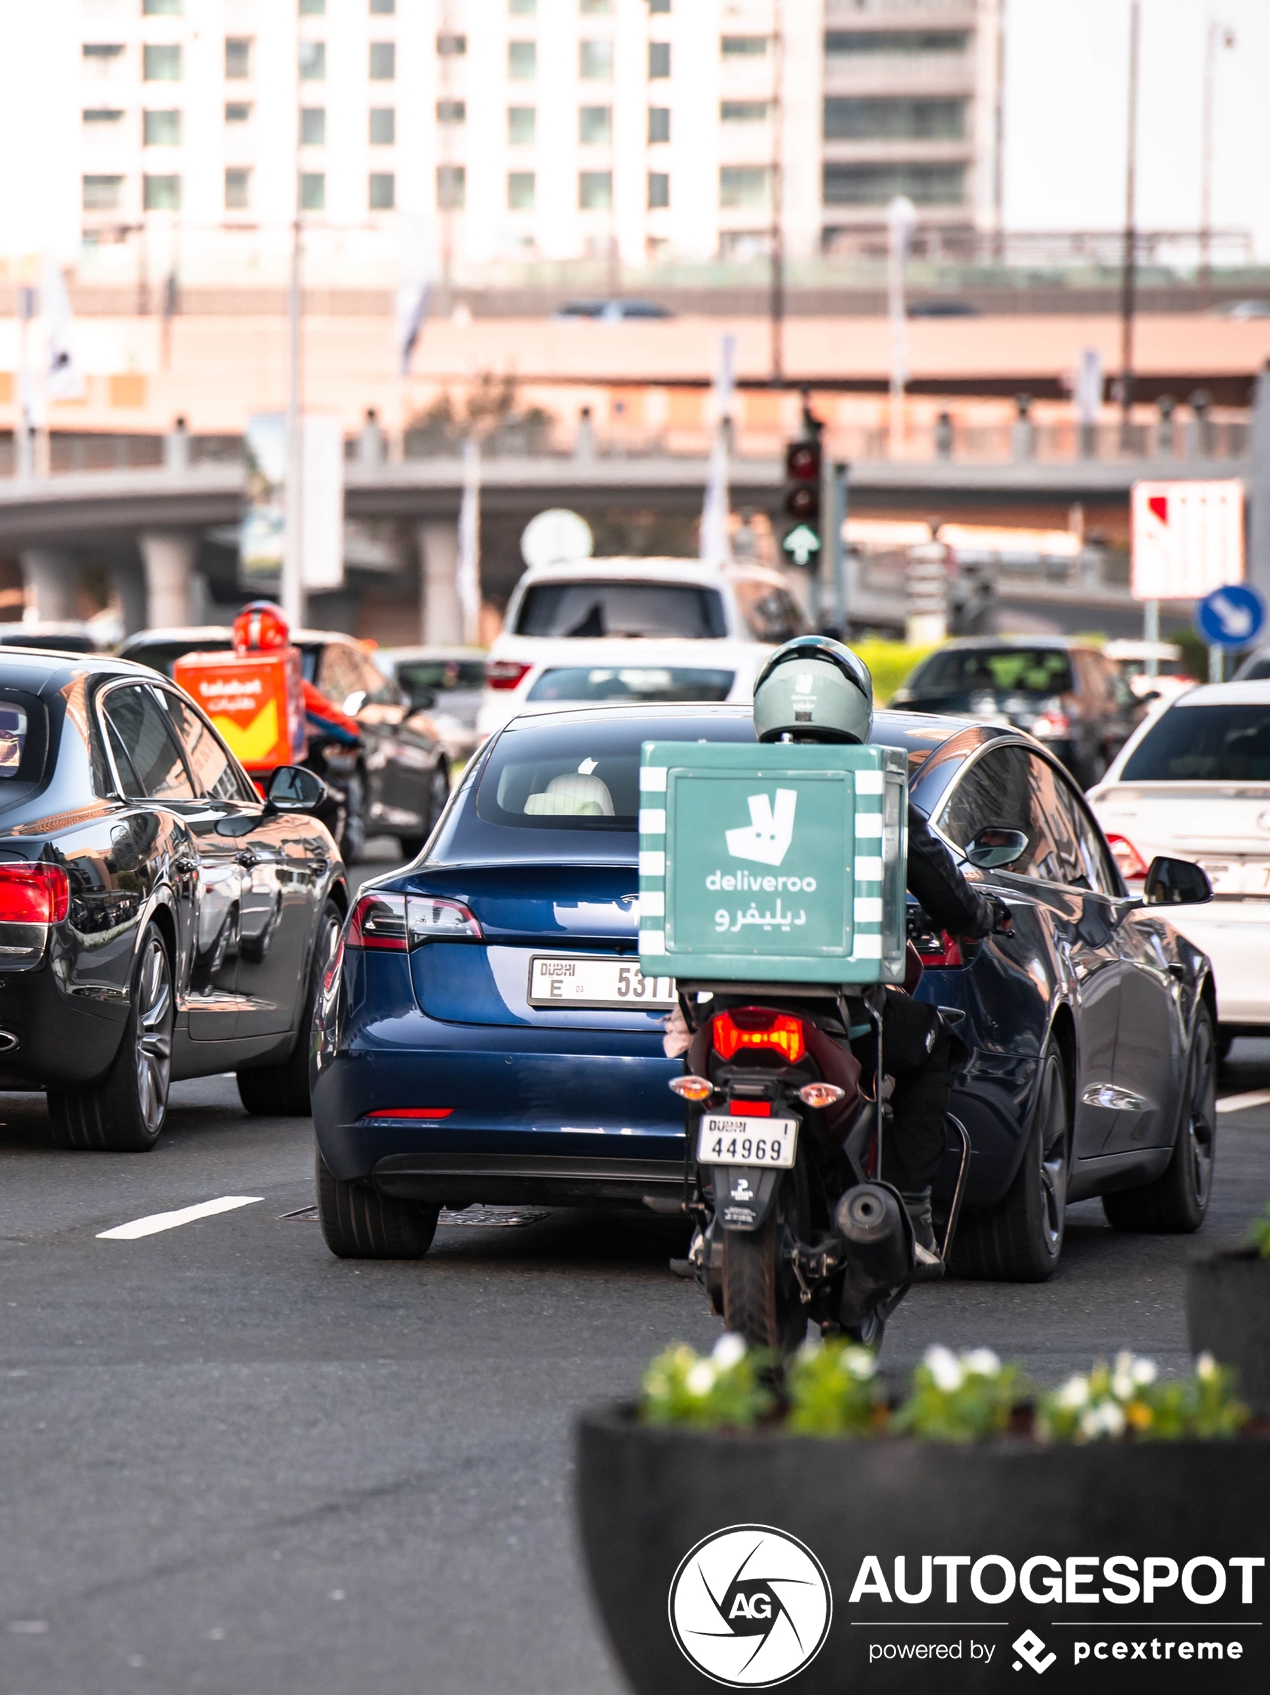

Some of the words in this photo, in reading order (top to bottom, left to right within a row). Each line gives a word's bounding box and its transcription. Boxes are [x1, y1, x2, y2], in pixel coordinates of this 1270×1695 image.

[706, 869, 817, 892] deliveroo
[715, 898, 806, 932] ديليفرو
[550, 979, 564, 998] E
[712, 1137, 782, 1161] 44969
